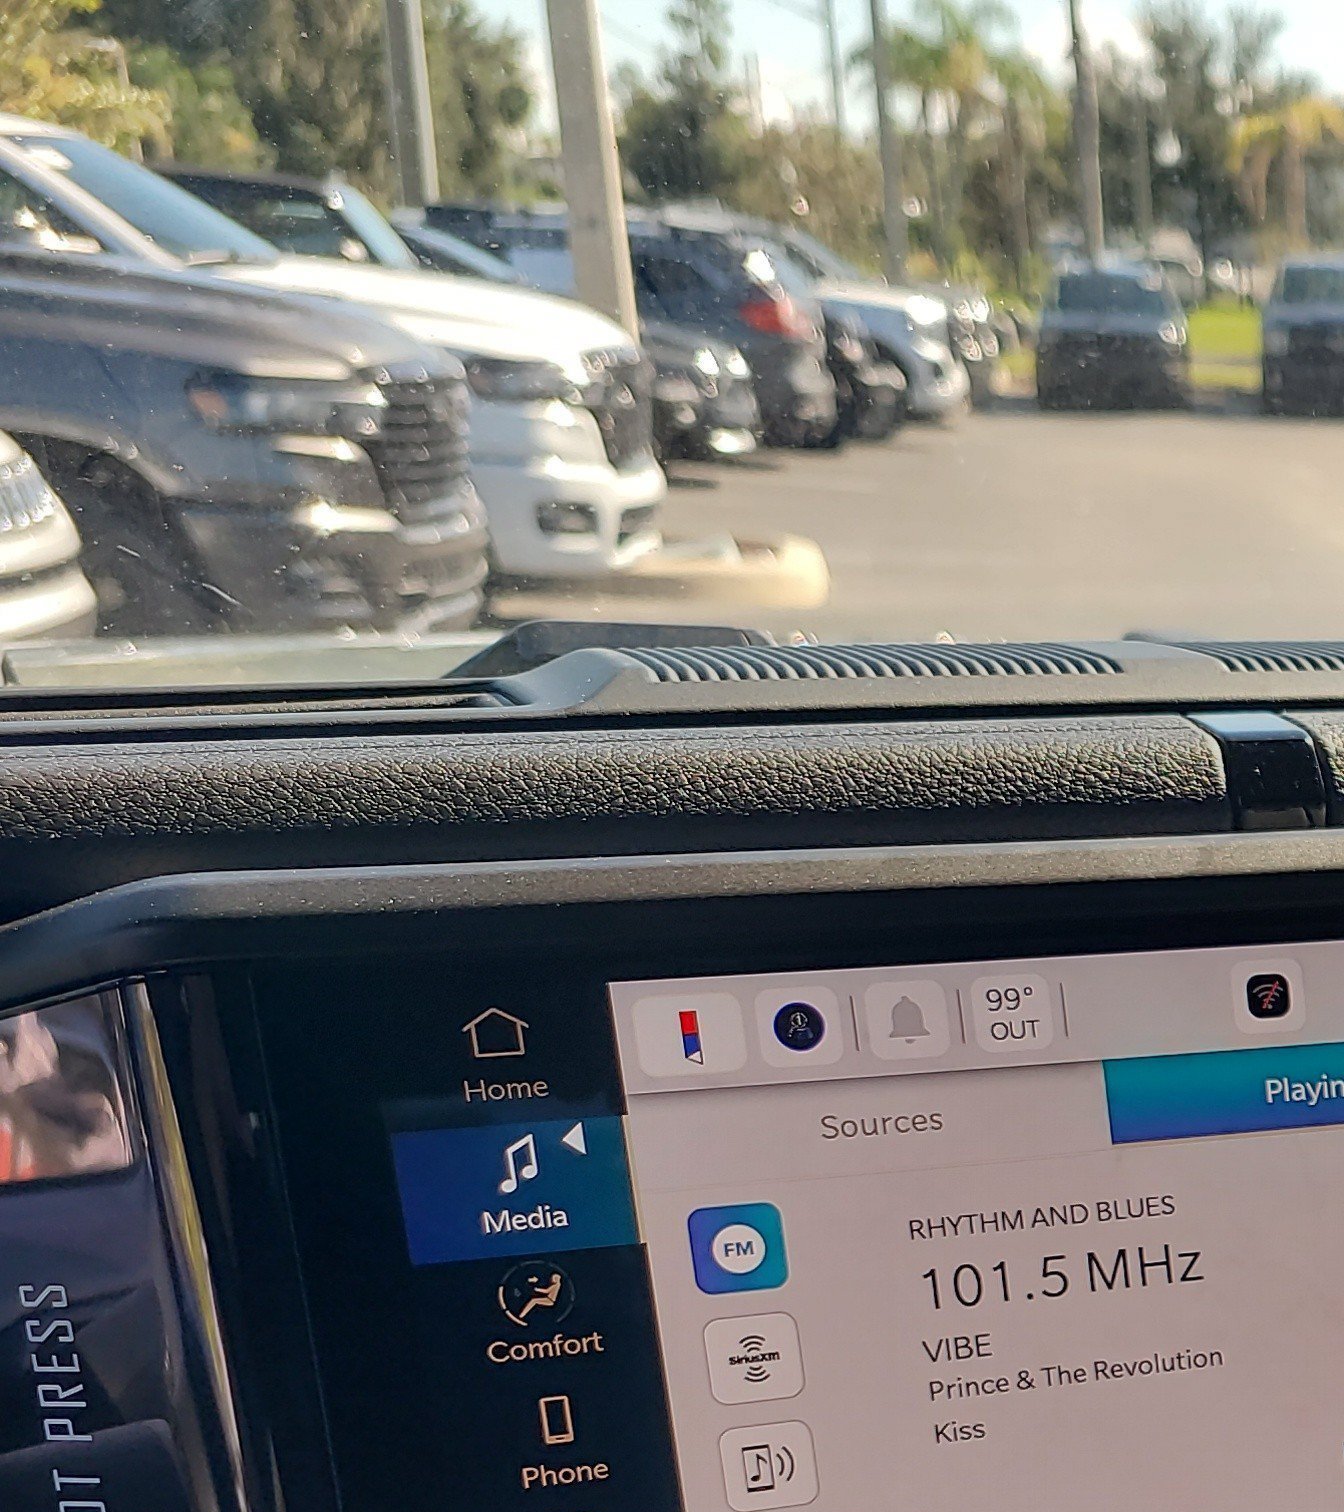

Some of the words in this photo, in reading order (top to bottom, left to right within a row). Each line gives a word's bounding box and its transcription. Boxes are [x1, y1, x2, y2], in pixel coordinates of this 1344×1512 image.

[985, 986, 1034, 1014] 99°
[990, 1018, 1040, 1042] OUT
[464, 1074, 549, 1104] Home
[820, 1109, 944, 1140] Sources
[482, 1204, 568, 1236] Media
[909, 1211, 1024, 1241] RHYTHM
[1031, 1203, 1089, 1230] AND
[1095, 1195, 1175, 1223] BLUES
[724, 1240, 754, 1257] FM
[920, 1255, 1070, 1311] 101.5
[1087, 1243, 1205, 1294] MHz
[487, 1330, 604, 1363] Comfort
[922, 1333, 993, 1364] VIBE
[19, 1283, 94, 1442] PRESS
[928, 1370, 1010, 1403] Prince
[1016, 1367, 1037, 1392] &
[1040, 1362, 1087, 1389] The
[1093, 1345, 1224, 1381] Revolution
[934, 1420, 986, 1446] Kiss
[522, 1458, 609, 1491] Phone
